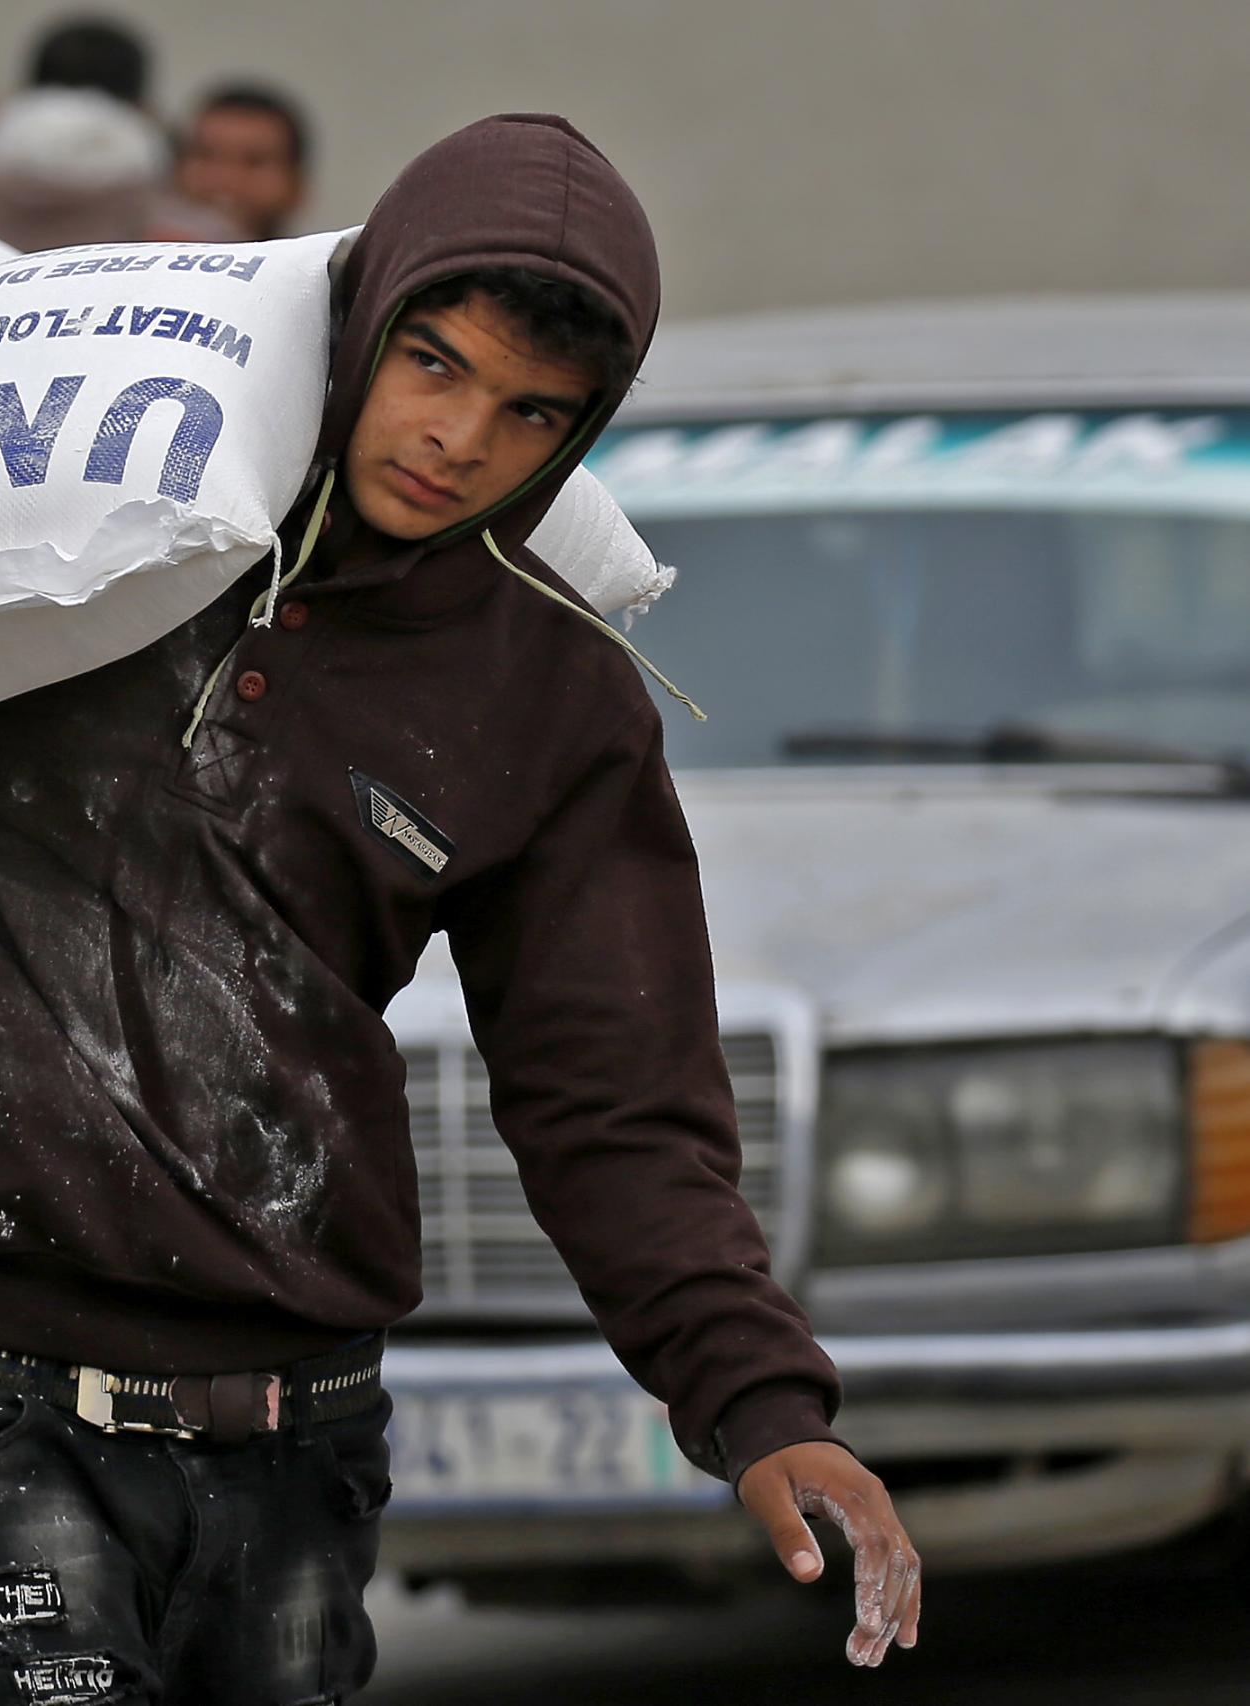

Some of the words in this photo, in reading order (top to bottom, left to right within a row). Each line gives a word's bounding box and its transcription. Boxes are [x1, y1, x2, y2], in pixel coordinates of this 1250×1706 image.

[46, 254, 164, 280] FREE
[167, 254, 265, 283] FOR
[94, 304, 253, 368] WHEAT
